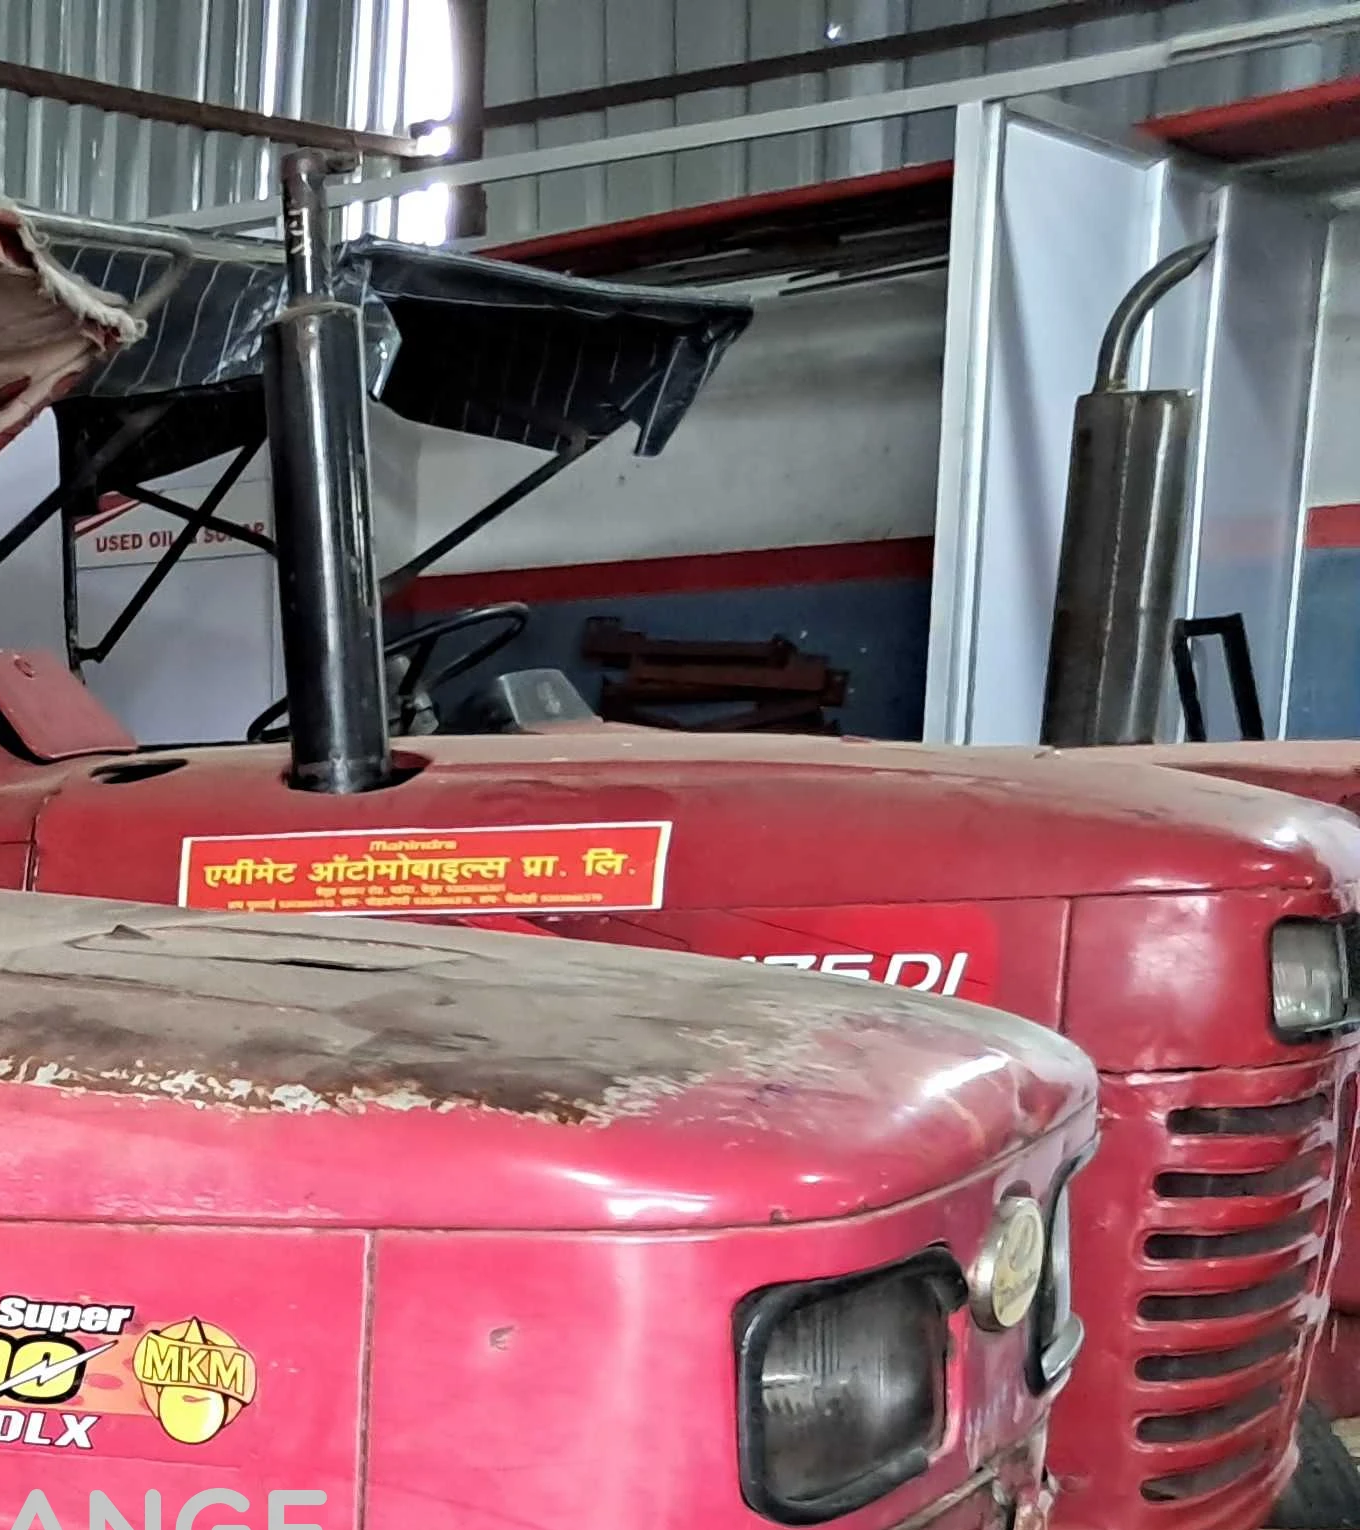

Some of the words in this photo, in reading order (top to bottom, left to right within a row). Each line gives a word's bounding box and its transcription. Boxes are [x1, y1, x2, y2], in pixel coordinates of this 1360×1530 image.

[96, 531, 143, 552] USED
[204, 858, 298, 887] एग्रीमेट
[308, 851, 511, 884] ऑटोमोबाइल्स
[142, 1336, 247, 1396] MKM
